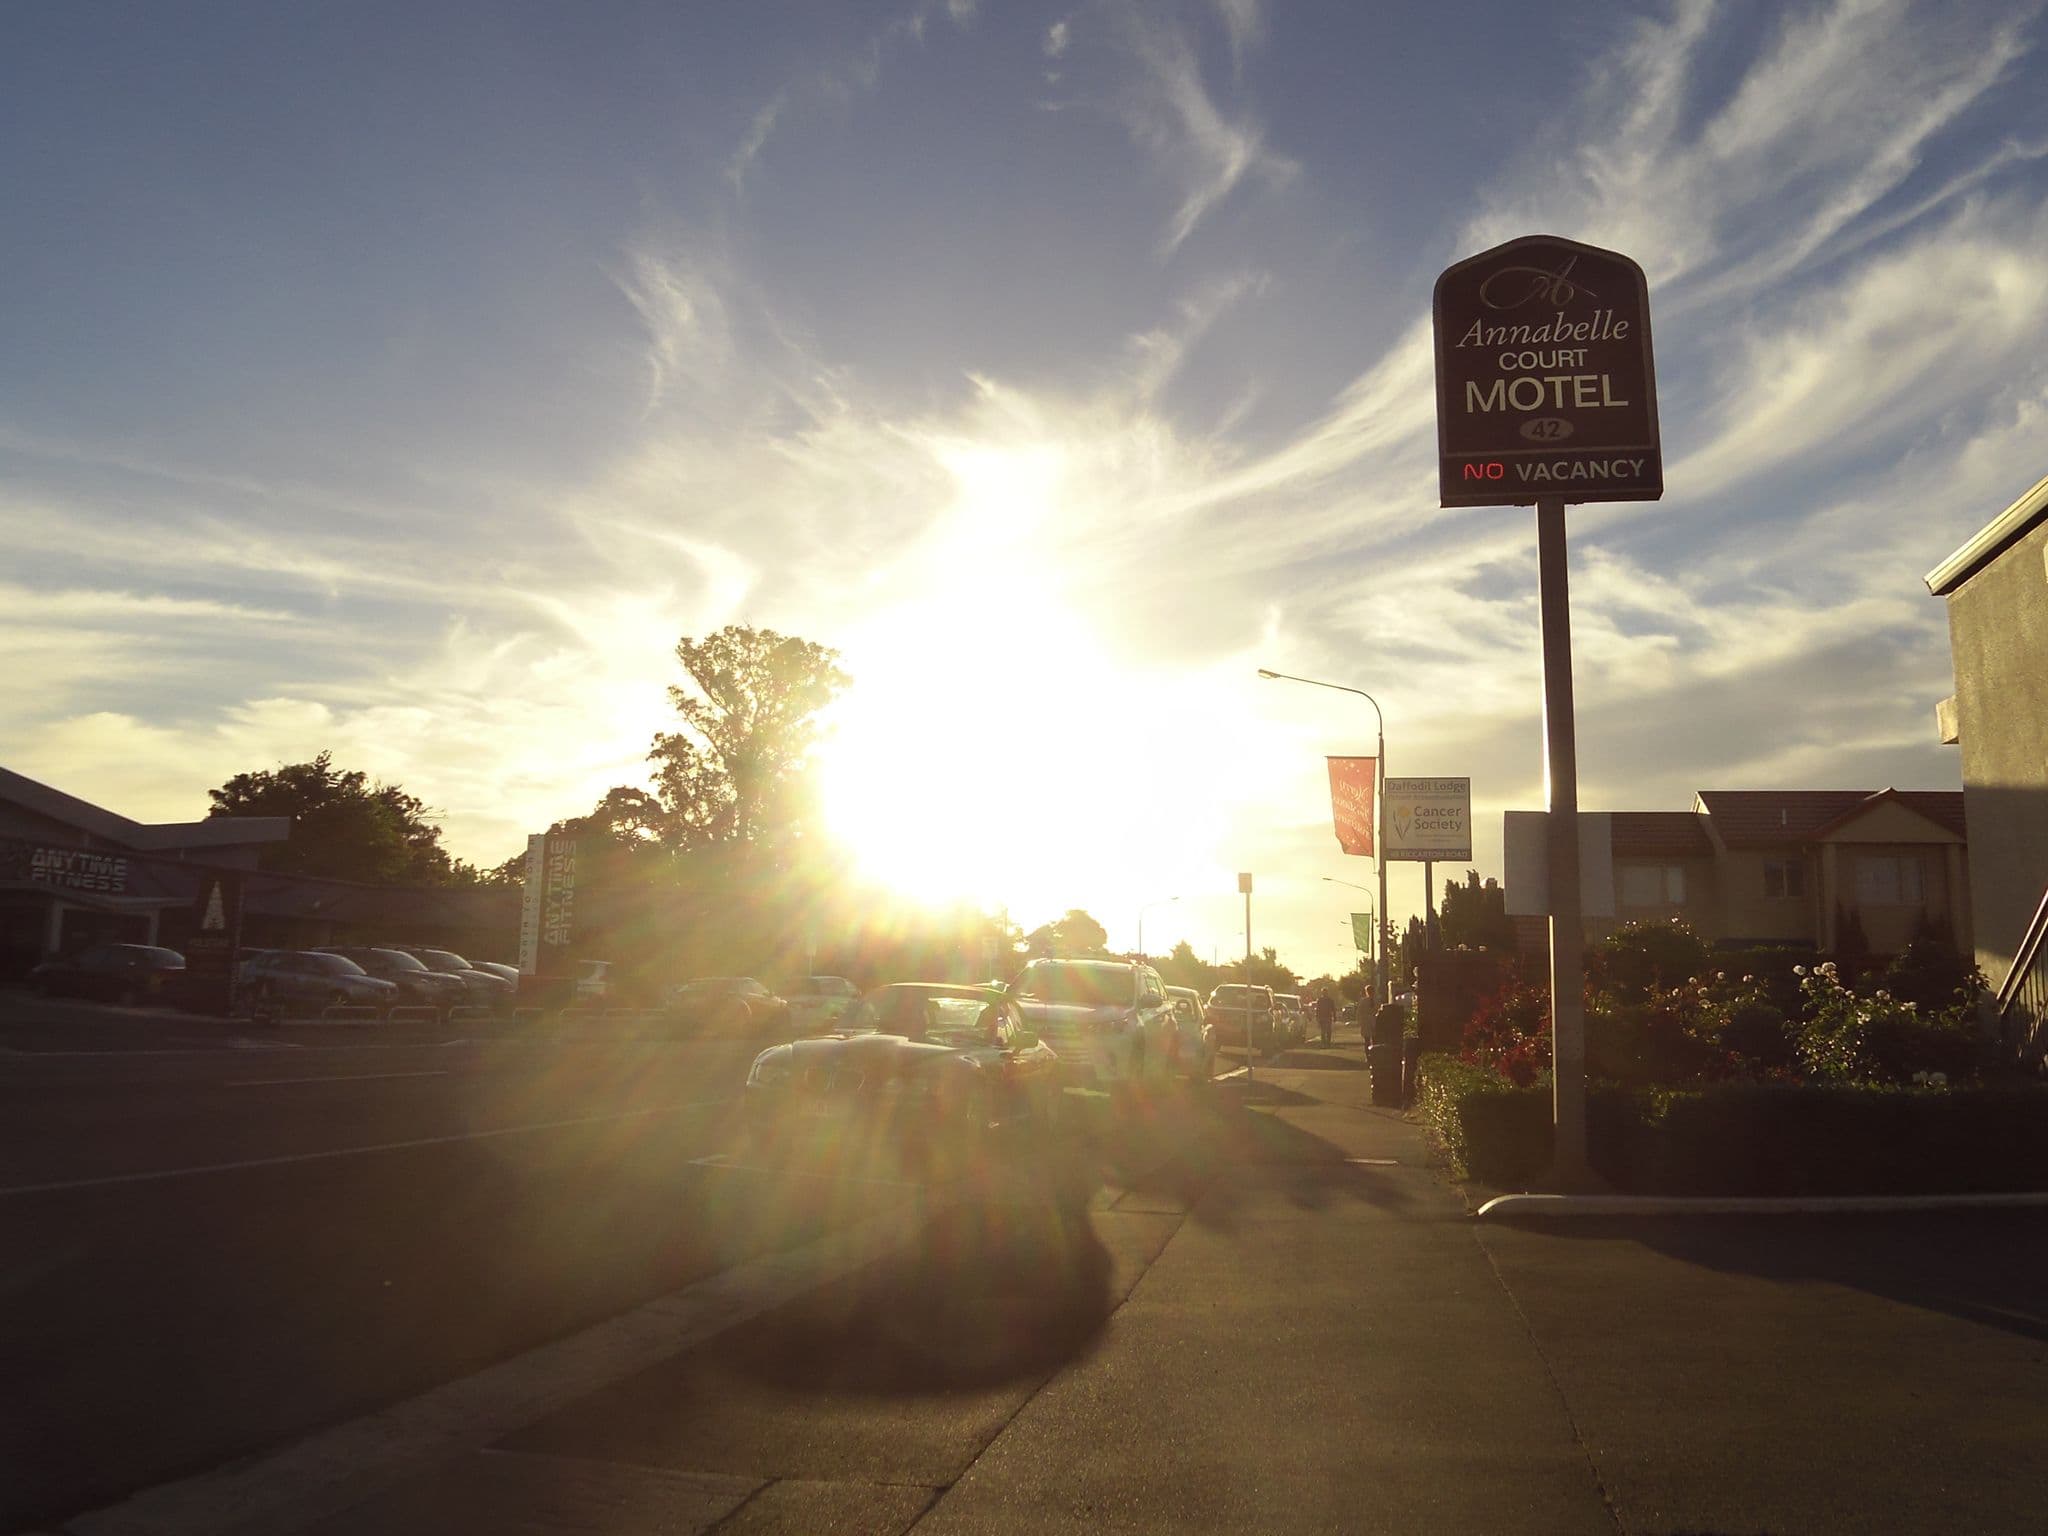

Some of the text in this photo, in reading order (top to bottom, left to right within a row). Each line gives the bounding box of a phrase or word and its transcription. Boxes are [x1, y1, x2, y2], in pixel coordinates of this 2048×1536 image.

[1456, 310, 1629, 348] Annabelle
[1499, 349, 1588, 371] COURT
[1466, 374, 1629, 413] MOTEL
[1531, 423, 1561, 438] 42
[1464, 459, 1645, 481] NO VACANCY
[1434, 781, 1466, 793] Lodge
[1414, 806, 1461, 817] Cancer
[1414, 818, 1461, 832] Society
[31, 848, 128, 876] ANYTIME
[32, 867, 126, 892] FITNESS
[544, 840, 565, 944] ANYTIME
[558, 839, 577, 944] FITNESS
